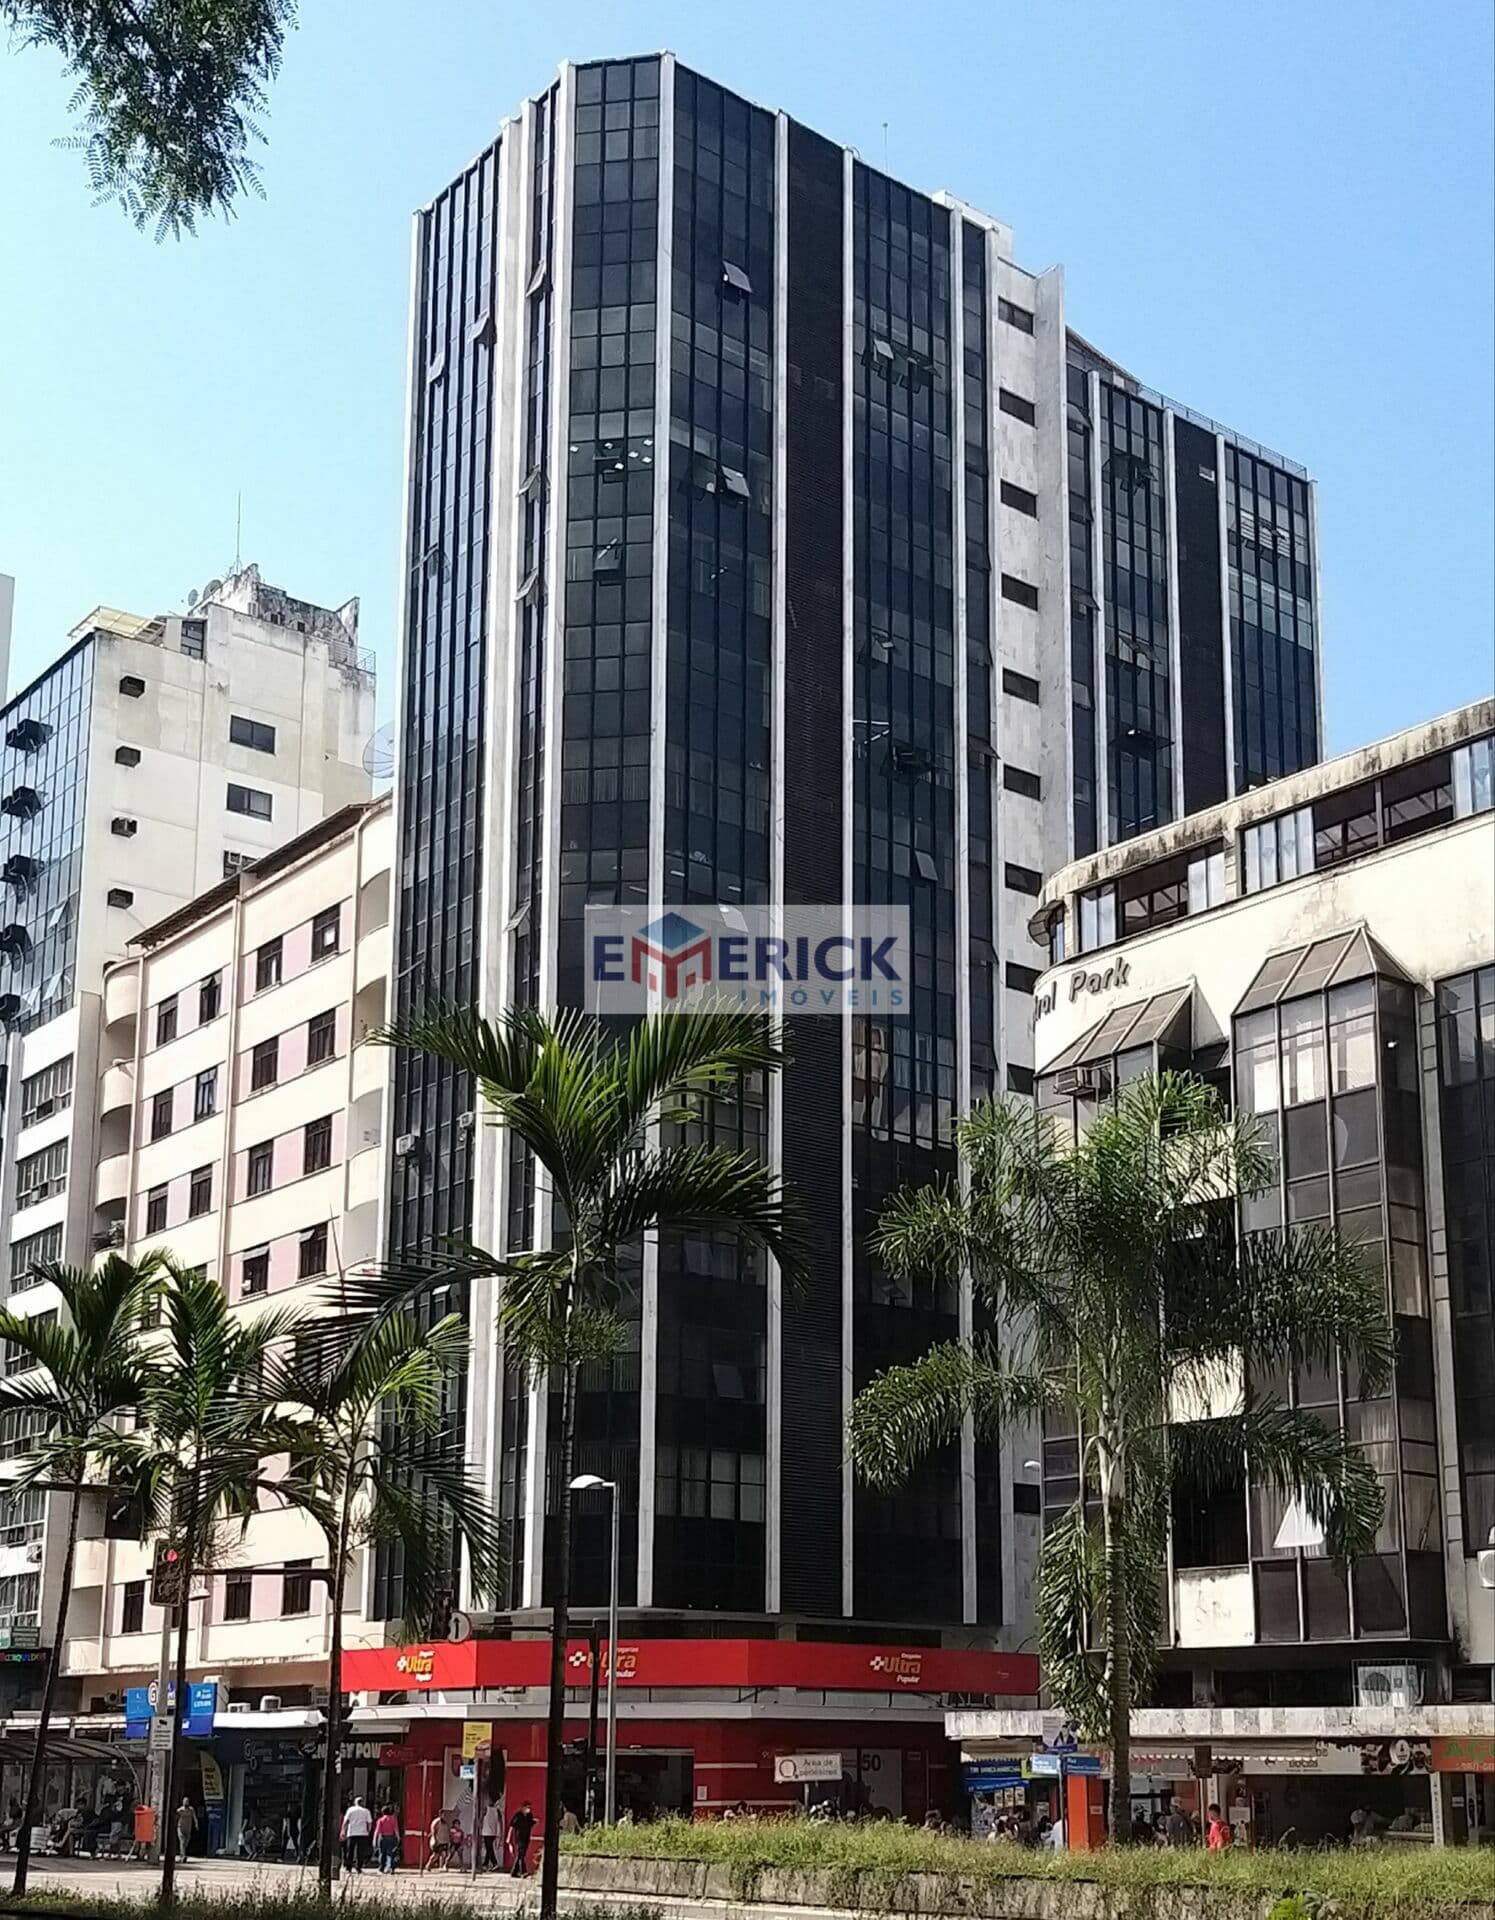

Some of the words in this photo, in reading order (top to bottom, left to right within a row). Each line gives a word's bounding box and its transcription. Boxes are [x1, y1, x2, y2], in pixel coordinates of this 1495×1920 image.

[1068, 956, 1131, 1003] Park
[405, 1655, 433, 1674] Ultra
[883, 1656, 921, 1674] Ultra
